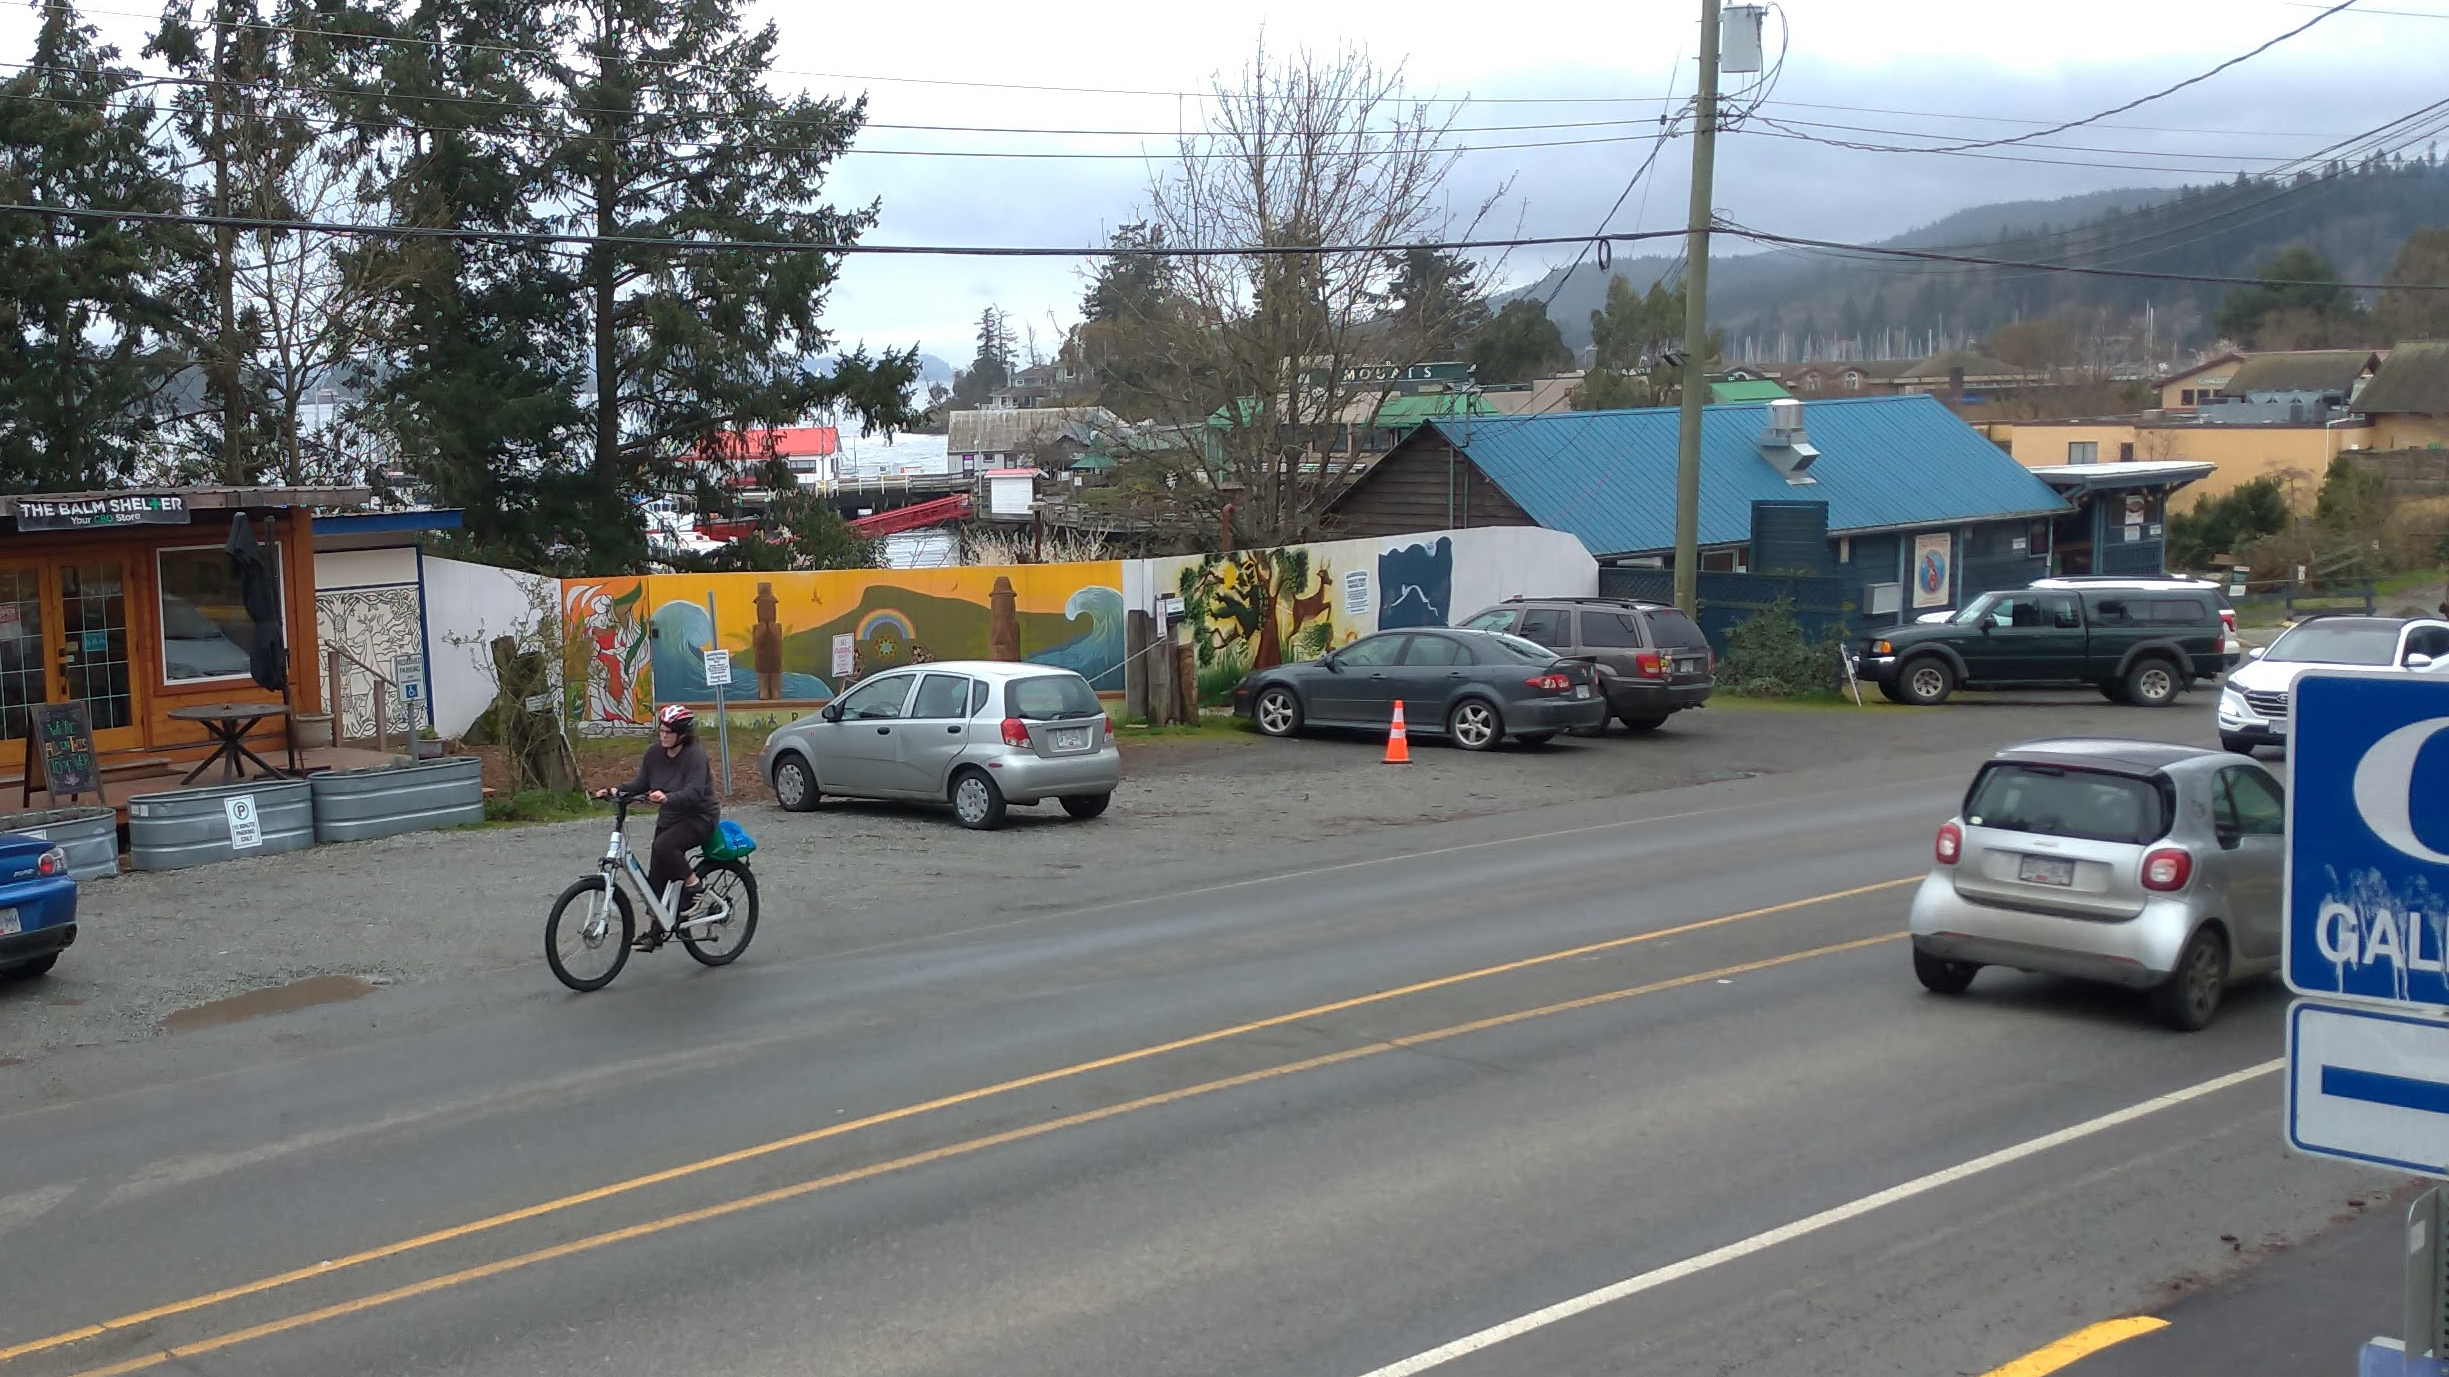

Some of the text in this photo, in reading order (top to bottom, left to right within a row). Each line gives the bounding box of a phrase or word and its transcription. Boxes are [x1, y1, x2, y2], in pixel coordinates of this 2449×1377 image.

[20, 503, 55, 517] THE
[59, 500, 105, 515] BALM
[71, 513, 141, 525] Your CBD Store
[400, 666, 421, 674] PARKING
[2316, 902, 2449, 973] GAL
